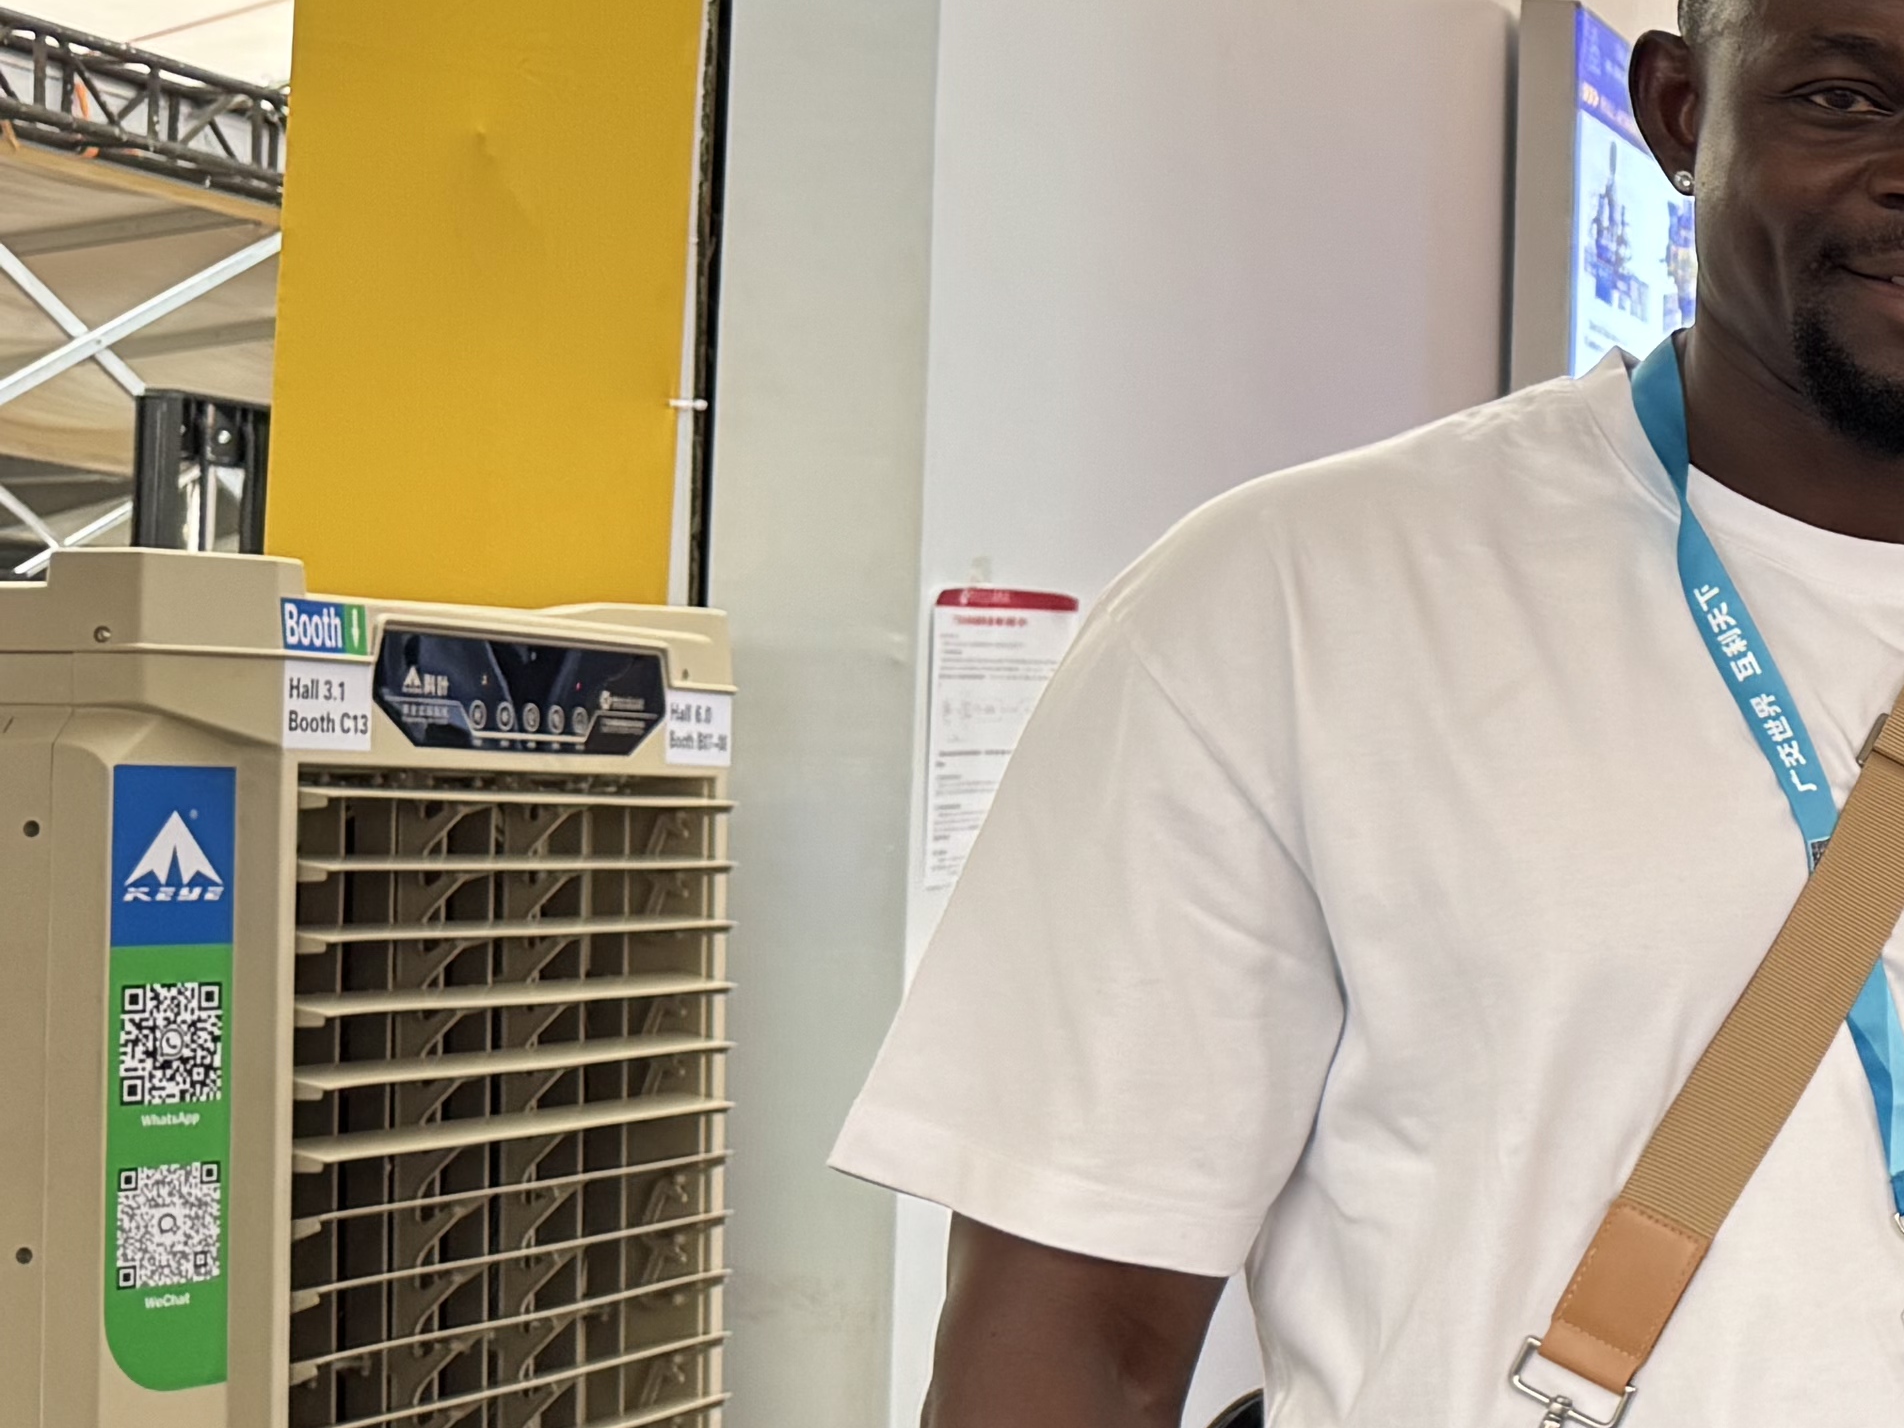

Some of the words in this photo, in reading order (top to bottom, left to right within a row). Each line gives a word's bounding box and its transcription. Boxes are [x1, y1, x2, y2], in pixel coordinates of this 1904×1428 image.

[284, 602, 342, 648] Booth
[1693, 584, 1762, 682] 互利天下
[289, 677, 319, 701] Hall
[323, 679, 345, 702] 3.1
[288, 710, 335, 734] Booth
[340, 713, 369, 735] C13
[1750, 693, 1817, 792] 广交世界
[141, 1111, 200, 1127] WhatsApp
[144, 1292, 191, 1309] WeChat
